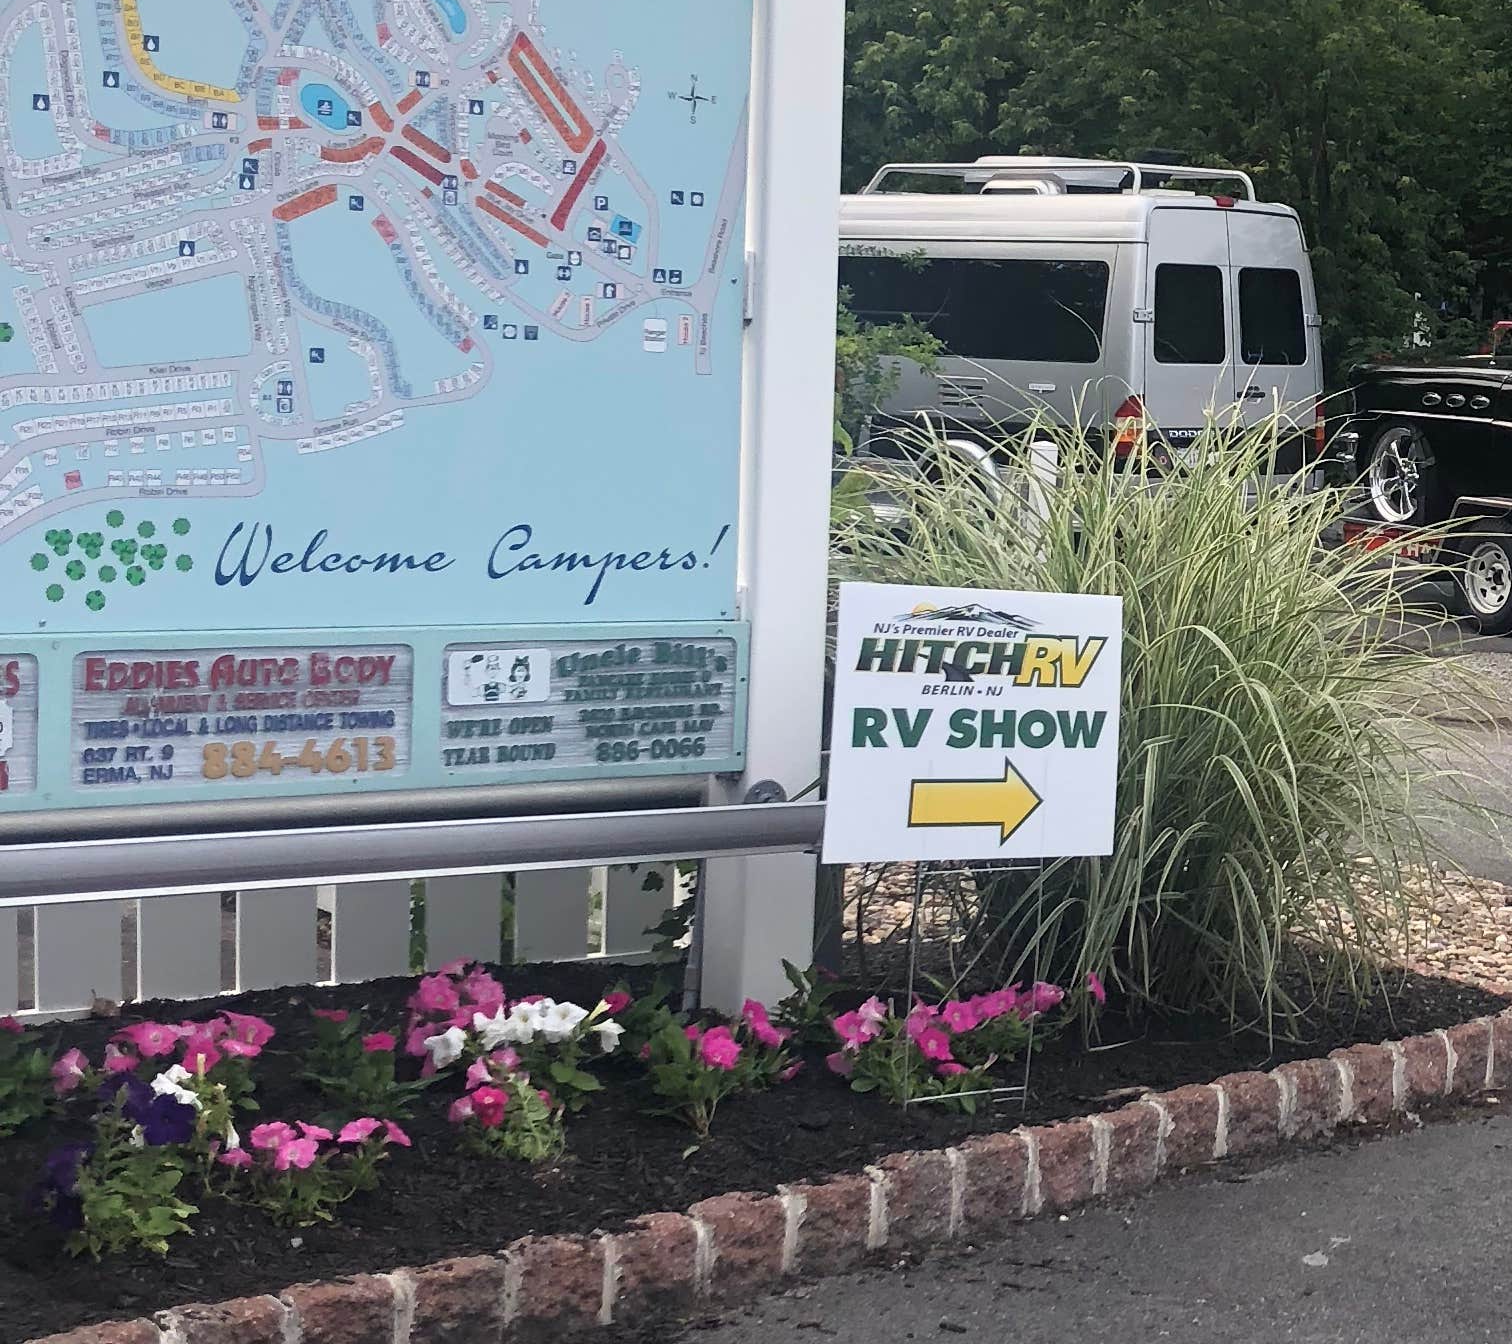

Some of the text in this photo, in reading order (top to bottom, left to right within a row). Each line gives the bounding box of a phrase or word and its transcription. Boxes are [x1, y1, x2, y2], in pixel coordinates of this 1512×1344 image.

[667, 91, 718, 105] W E
[689, 115, 697, 125] S
[213, 520, 731, 606] Welcome Campers!
[873, 622, 1020, 639] NJ's Premier RV Dealer
[84, 651, 397, 692] EDDIES AUTO BODY
[921, 684, 1004, 697] BERLIN NJ
[83, 719, 129, 740] TIRES
[140, 717, 192, 738] LOCAL
[215, 715, 258, 736] LONG
[262, 712, 334, 732] DISTANCE
[338, 709, 396, 730] TOWING
[851, 707, 1108, 749] RV SHOW
[202, 735, 397, 780] 884-4613
[495, 742, 556, 763] ROUND
[595, 736, 706, 762] 886-0066
[150, 763, 174, 781] NJ
